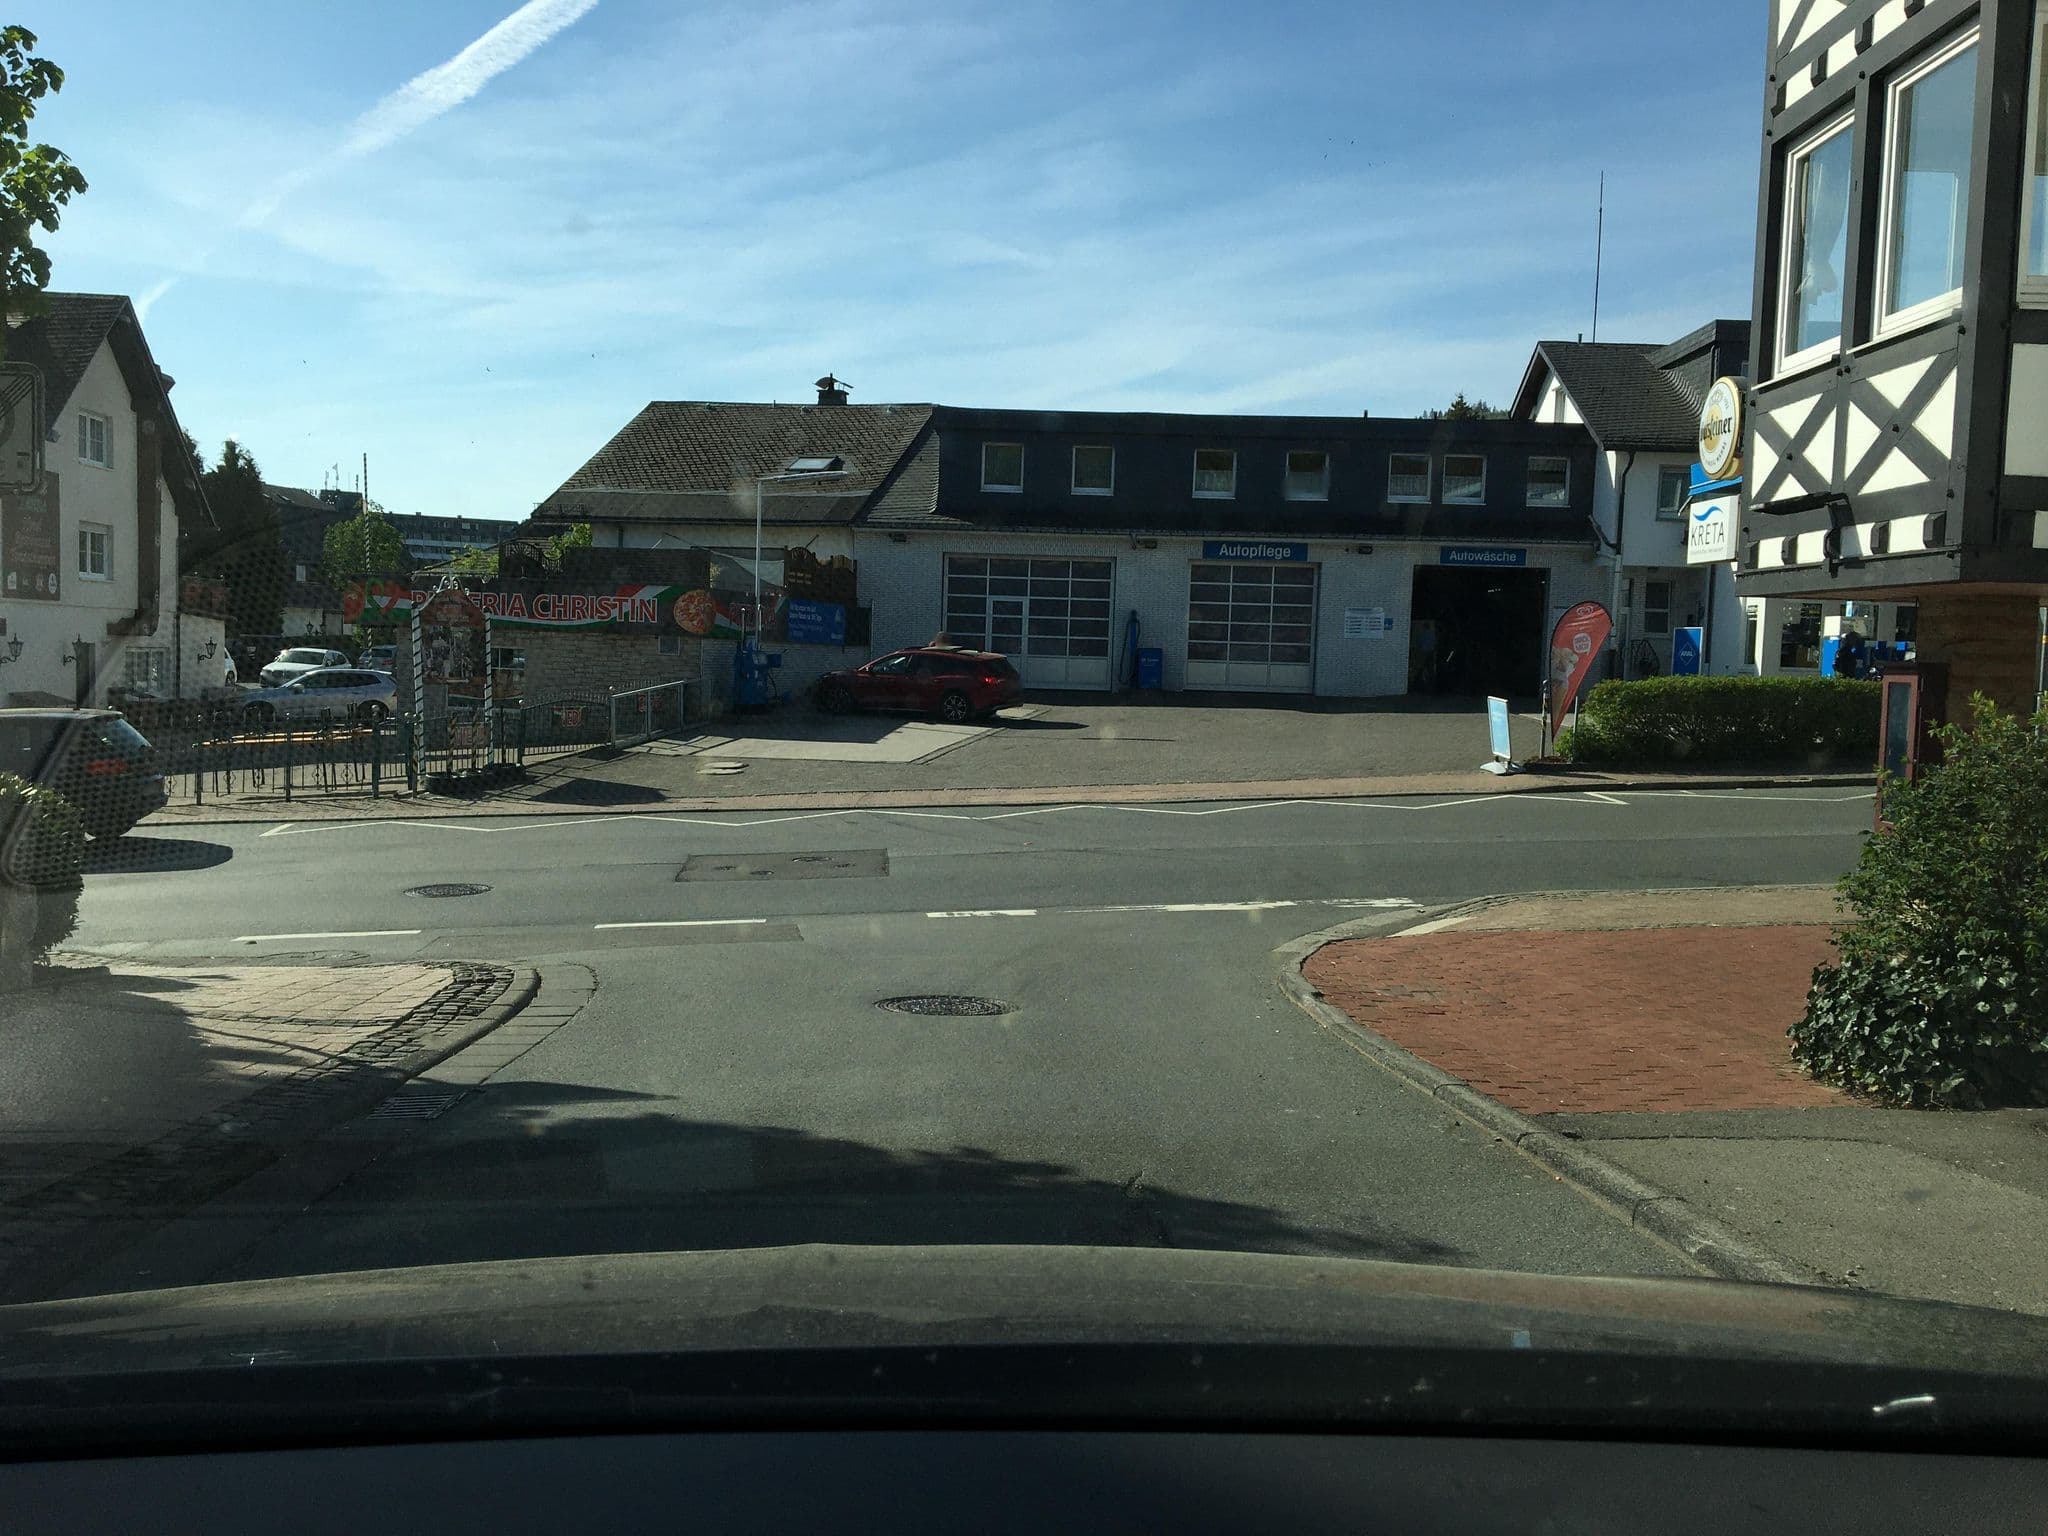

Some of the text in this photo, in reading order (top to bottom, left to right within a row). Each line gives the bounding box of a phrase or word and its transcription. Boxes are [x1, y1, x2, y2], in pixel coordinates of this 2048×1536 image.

[1690, 521, 1725, 546] KRETA
[1219, 543, 1291, 560] Autopflege
[1448, 549, 1517, 562] Autowäsche
[411, 590, 529, 617] PERIA
[532, 594, 658, 623] CHRISTIN
